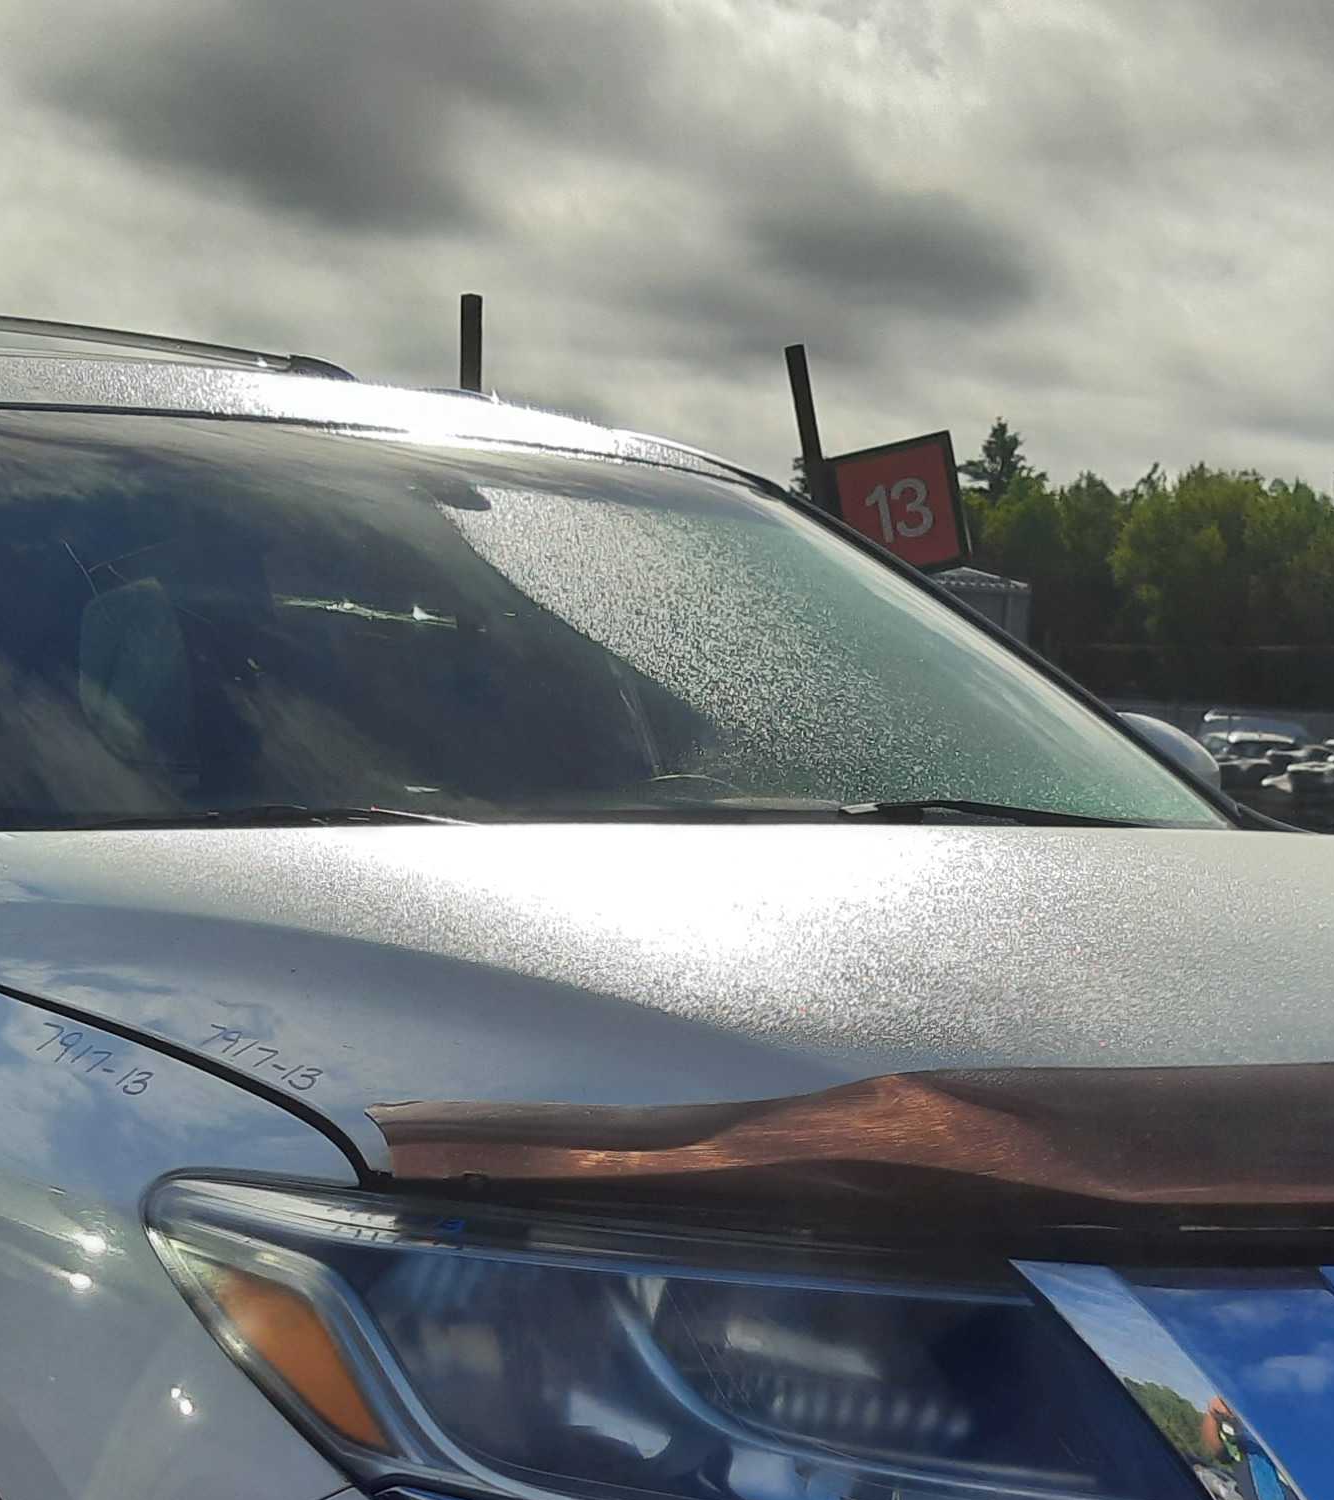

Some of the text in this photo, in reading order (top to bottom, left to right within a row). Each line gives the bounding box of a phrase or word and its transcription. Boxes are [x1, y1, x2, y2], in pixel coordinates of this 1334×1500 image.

[865, 477, 935, 544] 13
[35, 1021, 155, 1096] 7917-13
[199, 1023, 324, 1092] 7917-13
